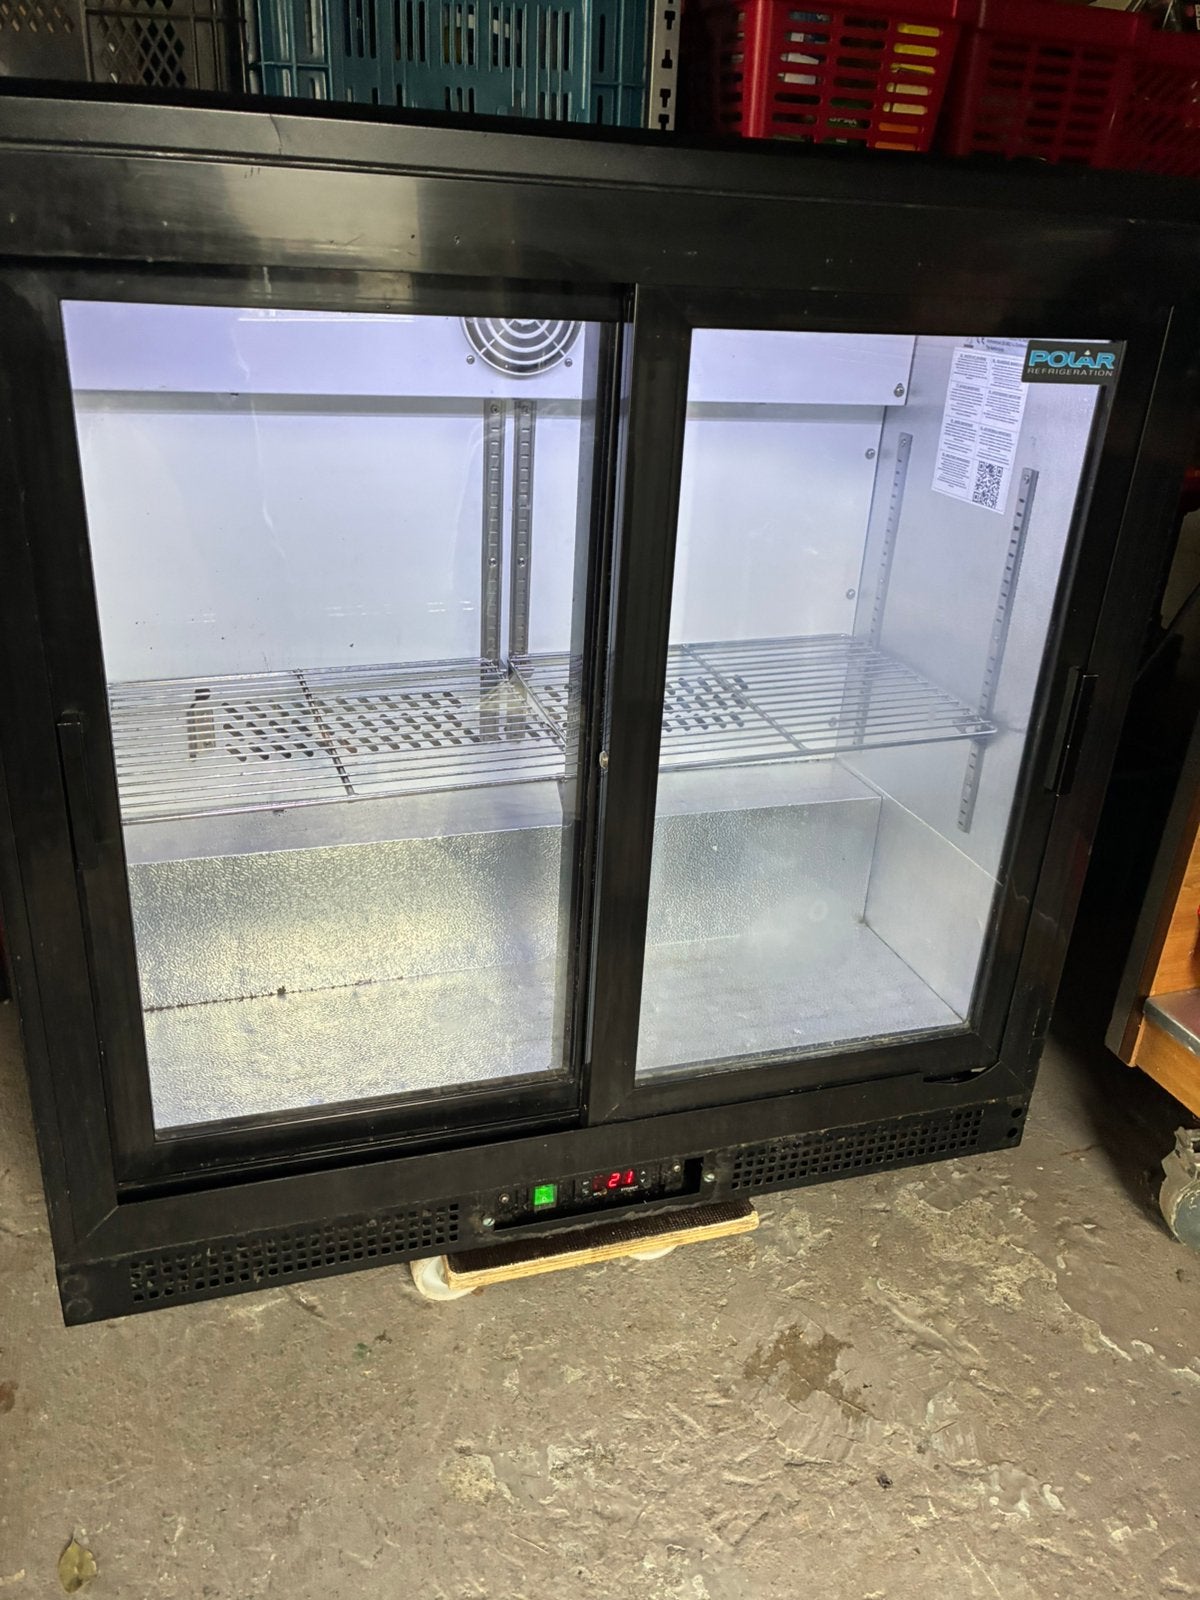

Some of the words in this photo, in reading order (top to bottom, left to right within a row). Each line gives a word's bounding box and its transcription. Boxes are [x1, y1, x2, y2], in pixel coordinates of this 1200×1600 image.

[1028, 350, 1115, 369] POLAR
[1027, 368, 1114, 377] REFRIGERATION
[608, 1171, 634, 1187] 21
